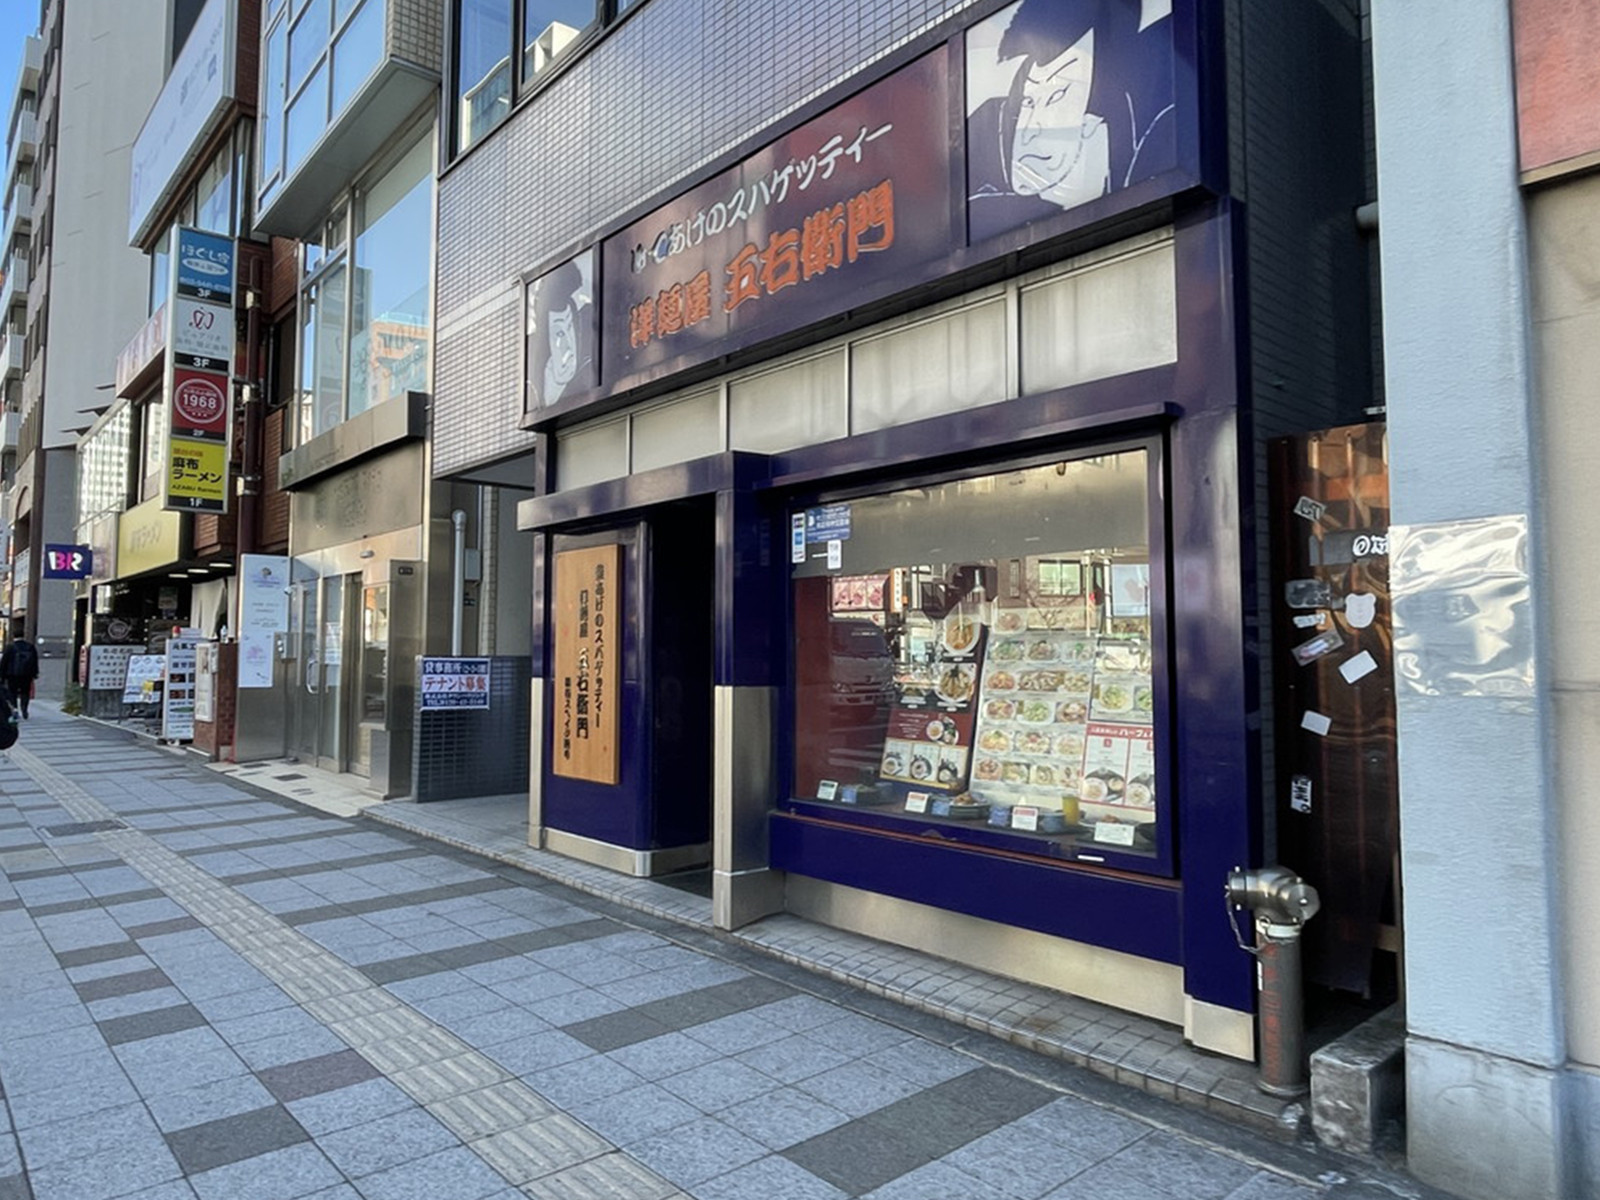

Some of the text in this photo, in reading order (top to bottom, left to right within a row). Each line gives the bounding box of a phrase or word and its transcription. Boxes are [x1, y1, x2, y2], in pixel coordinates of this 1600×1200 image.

[724, 179, 894, 313] 五右衛門
[197, 288, 211, 298] 3F
[193, 357, 210, 367] 3F
[183, 394, 217, 410] 1968
[193, 429, 205, 437] 2F
[173, 457, 199, 470] 麻布
[172, 468, 222, 484] ラーメン
[190, 498, 203, 507] 1F
[48, 551, 83, 571] BR
[425, 676, 486, 690] テナント募集
